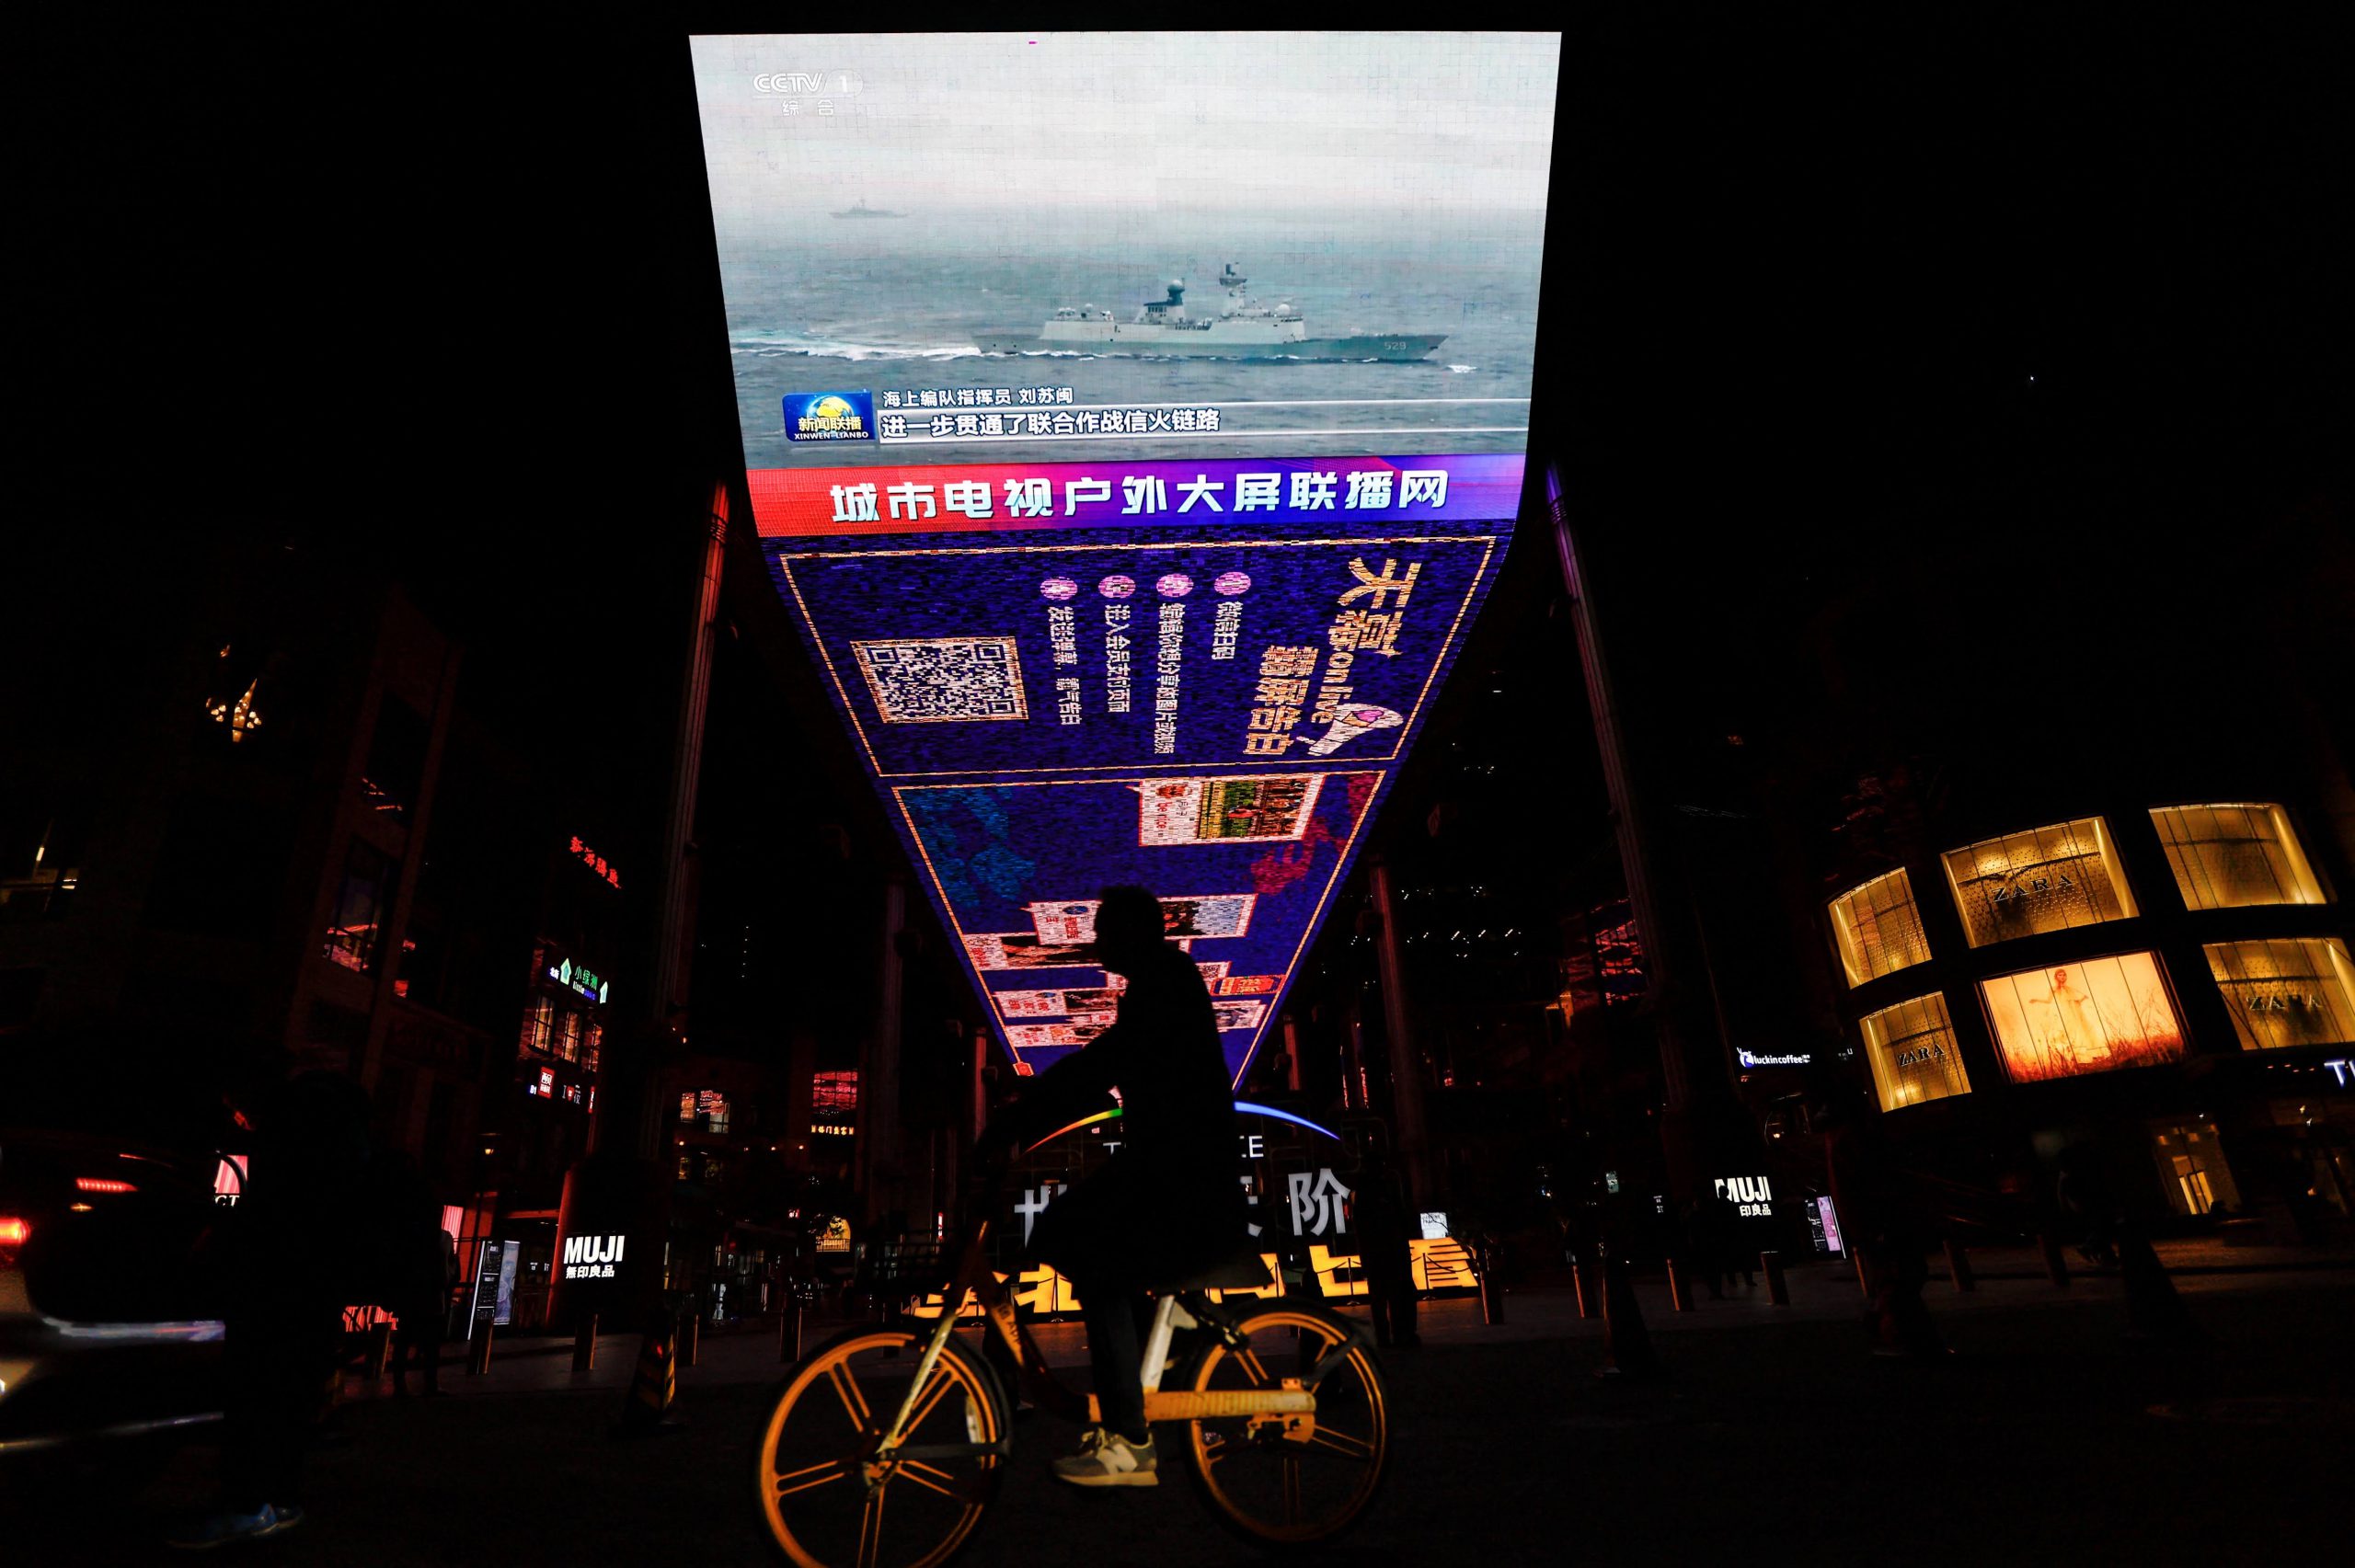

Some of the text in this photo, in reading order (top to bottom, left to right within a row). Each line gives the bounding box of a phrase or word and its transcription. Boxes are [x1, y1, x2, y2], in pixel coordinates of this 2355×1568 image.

[753, 73, 822, 92] CCTV
[1384, 341, 1407, 350] 529
[883, 387, 1074, 407] 海上编队指挥员 刘苏闽
[794, 431, 869, 441] XINWEN LIANBO
[798, 416, 862, 432] 新闻联播
[881, 408, 1221, 438] 进一步贯通了联合作战信火链路
[831, 470, 1448, 522] 城市电视户外大屏联播网
[1212, 601, 1243, 660] 微信扫码
[1105, 604, 1131, 713] 进入会员支付页面
[1324, 651, 1354, 683] on
[1311, 686, 1354, 724] live
[1991, 874, 2074, 902] ZARA
[1898, 1044, 1945, 1067] ZARA
[1714, 1176, 1772, 1203] MUJI
[564, 1235, 625, 1265] MUJI
[566, 1264, 615, 1279] 無印良品
